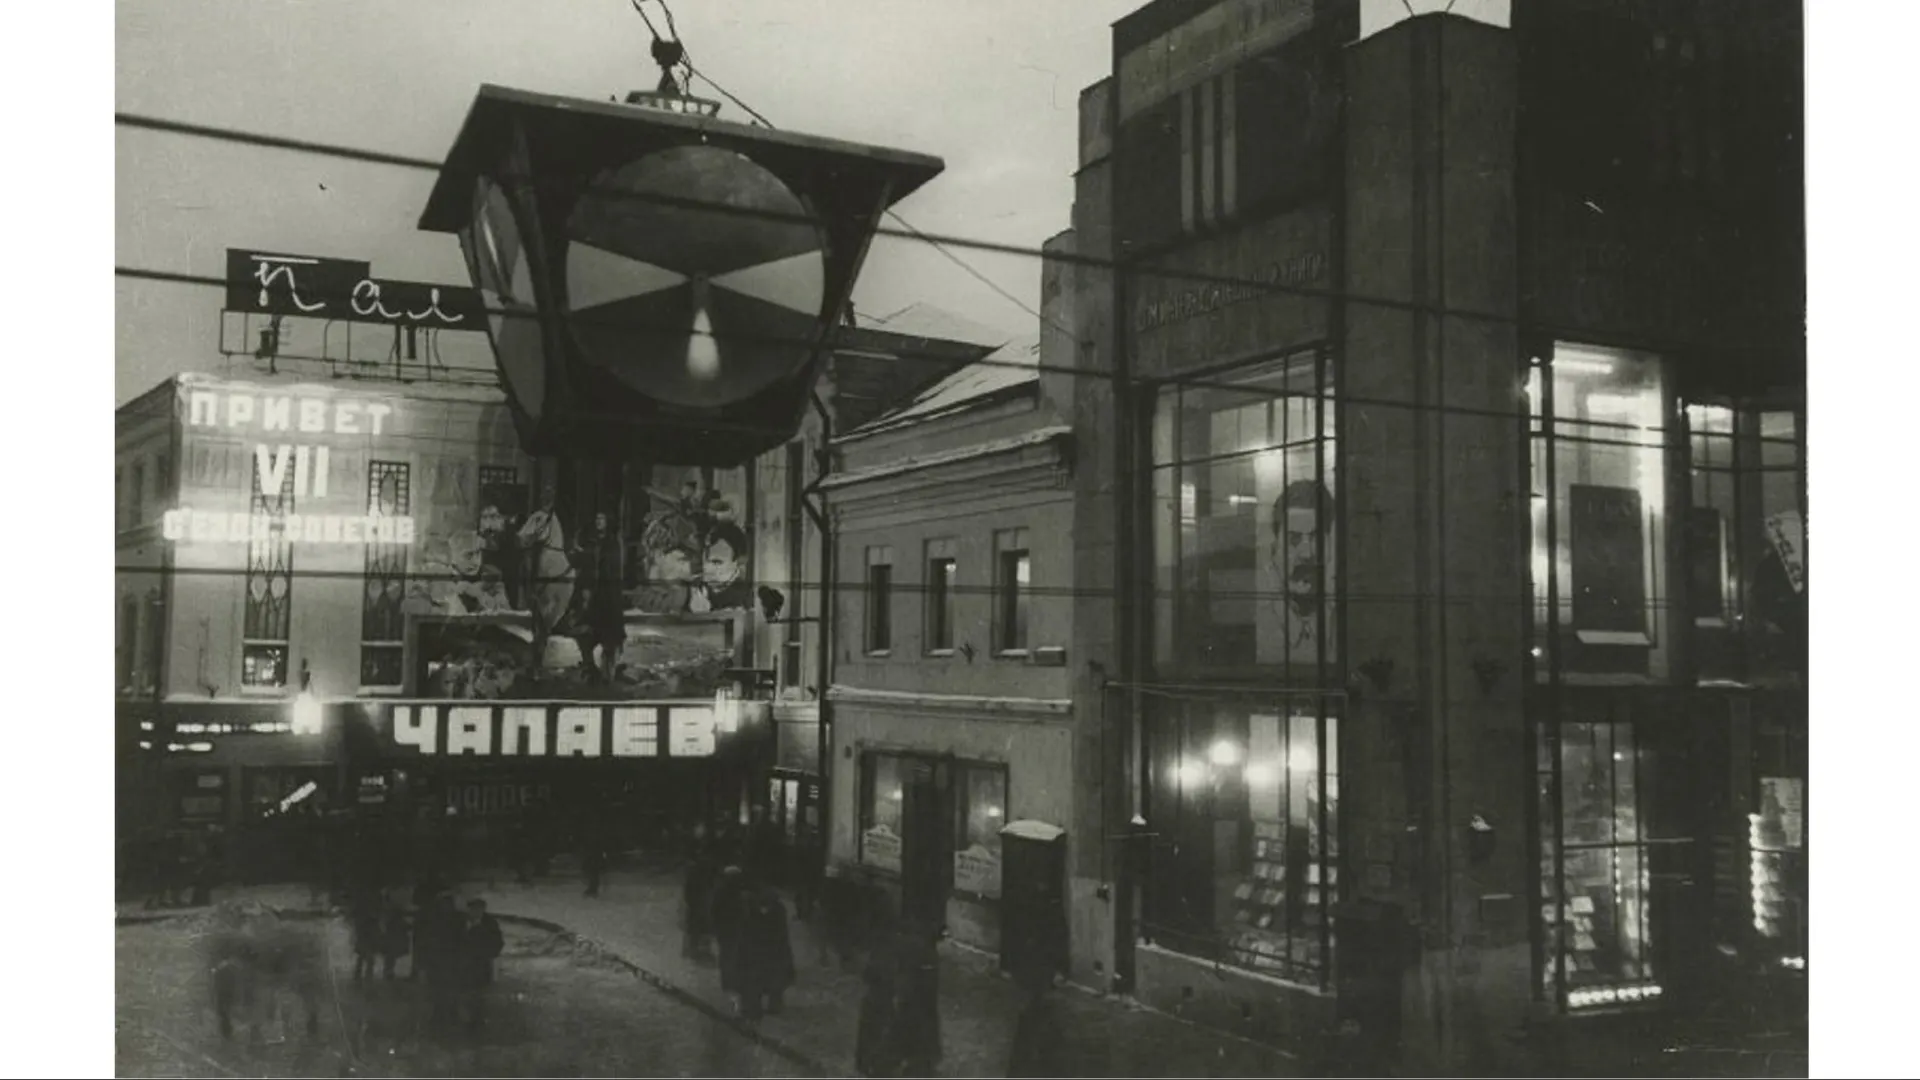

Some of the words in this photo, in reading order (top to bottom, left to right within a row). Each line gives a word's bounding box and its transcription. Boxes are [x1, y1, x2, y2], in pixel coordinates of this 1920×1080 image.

[190, 392, 391, 436] ПРИВЕТ
[256, 444, 329, 498] VII
[394, 707, 715, 756] ЧАПАЕВ
